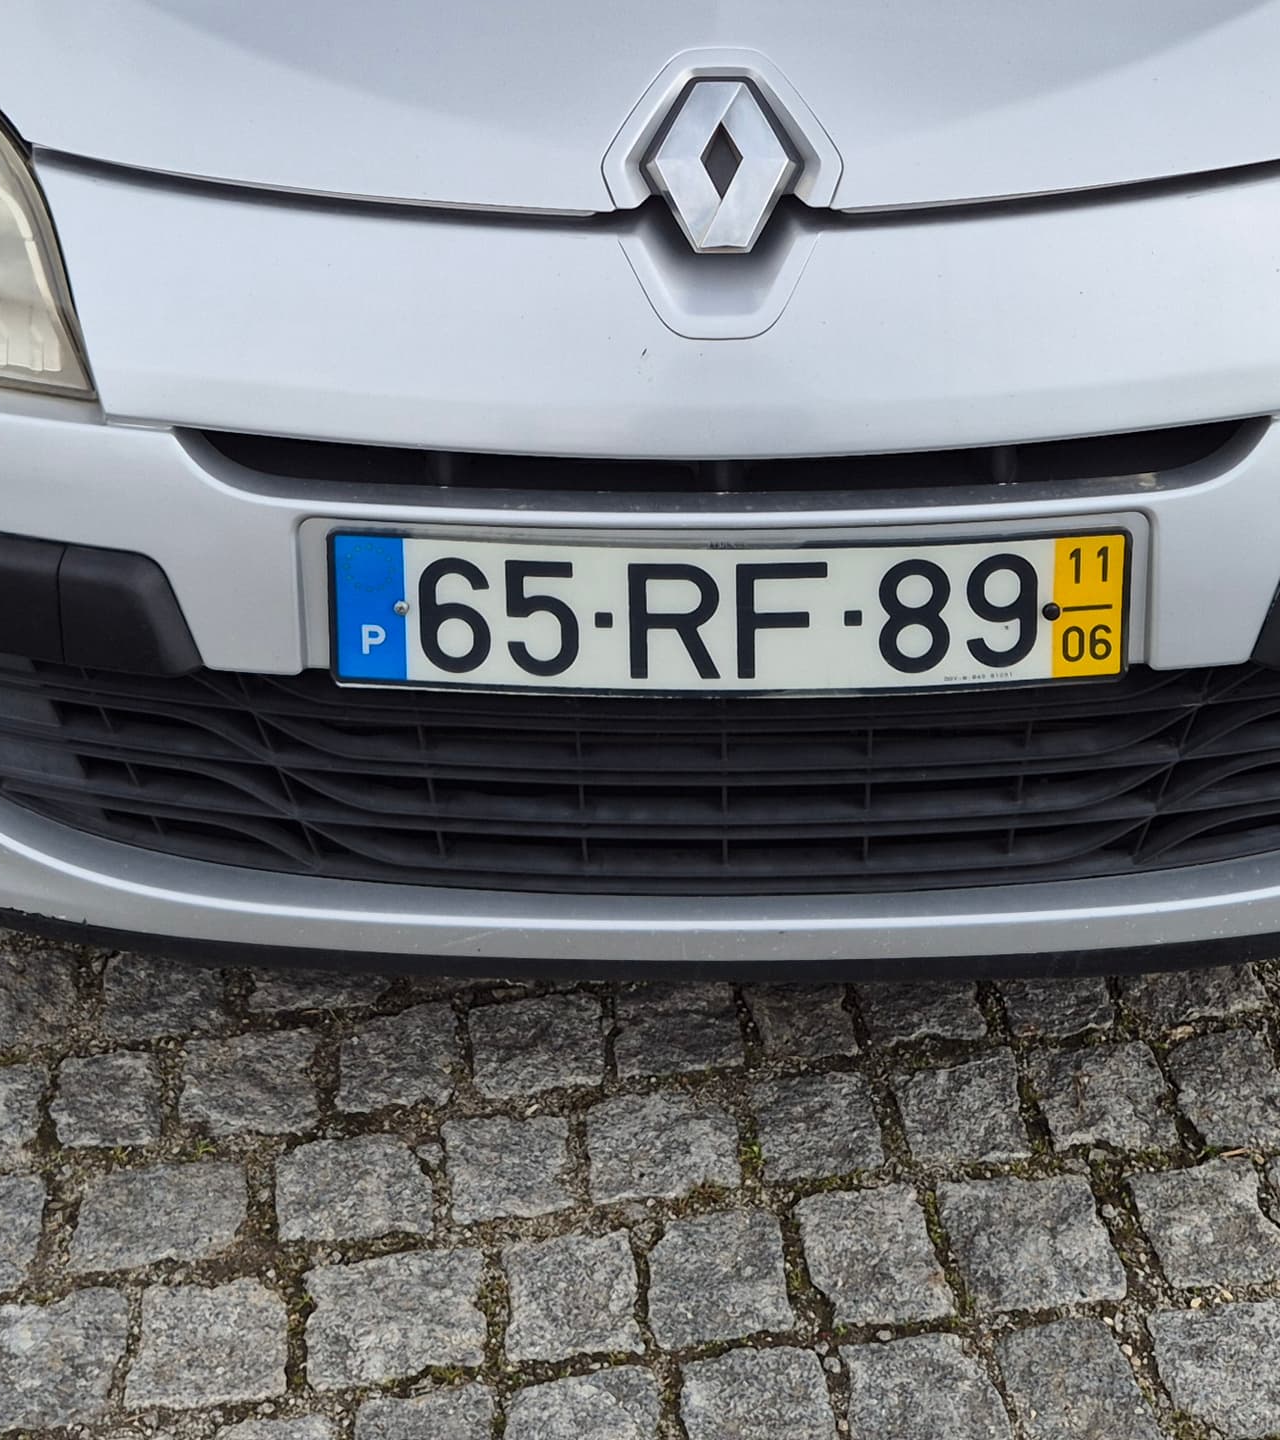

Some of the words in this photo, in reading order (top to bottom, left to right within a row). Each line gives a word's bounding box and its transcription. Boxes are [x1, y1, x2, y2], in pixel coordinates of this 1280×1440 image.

[1069, 546, 1109, 585] 11
[362, 624, 386, 655] P
[1062, 624, 1112, 662] 06
